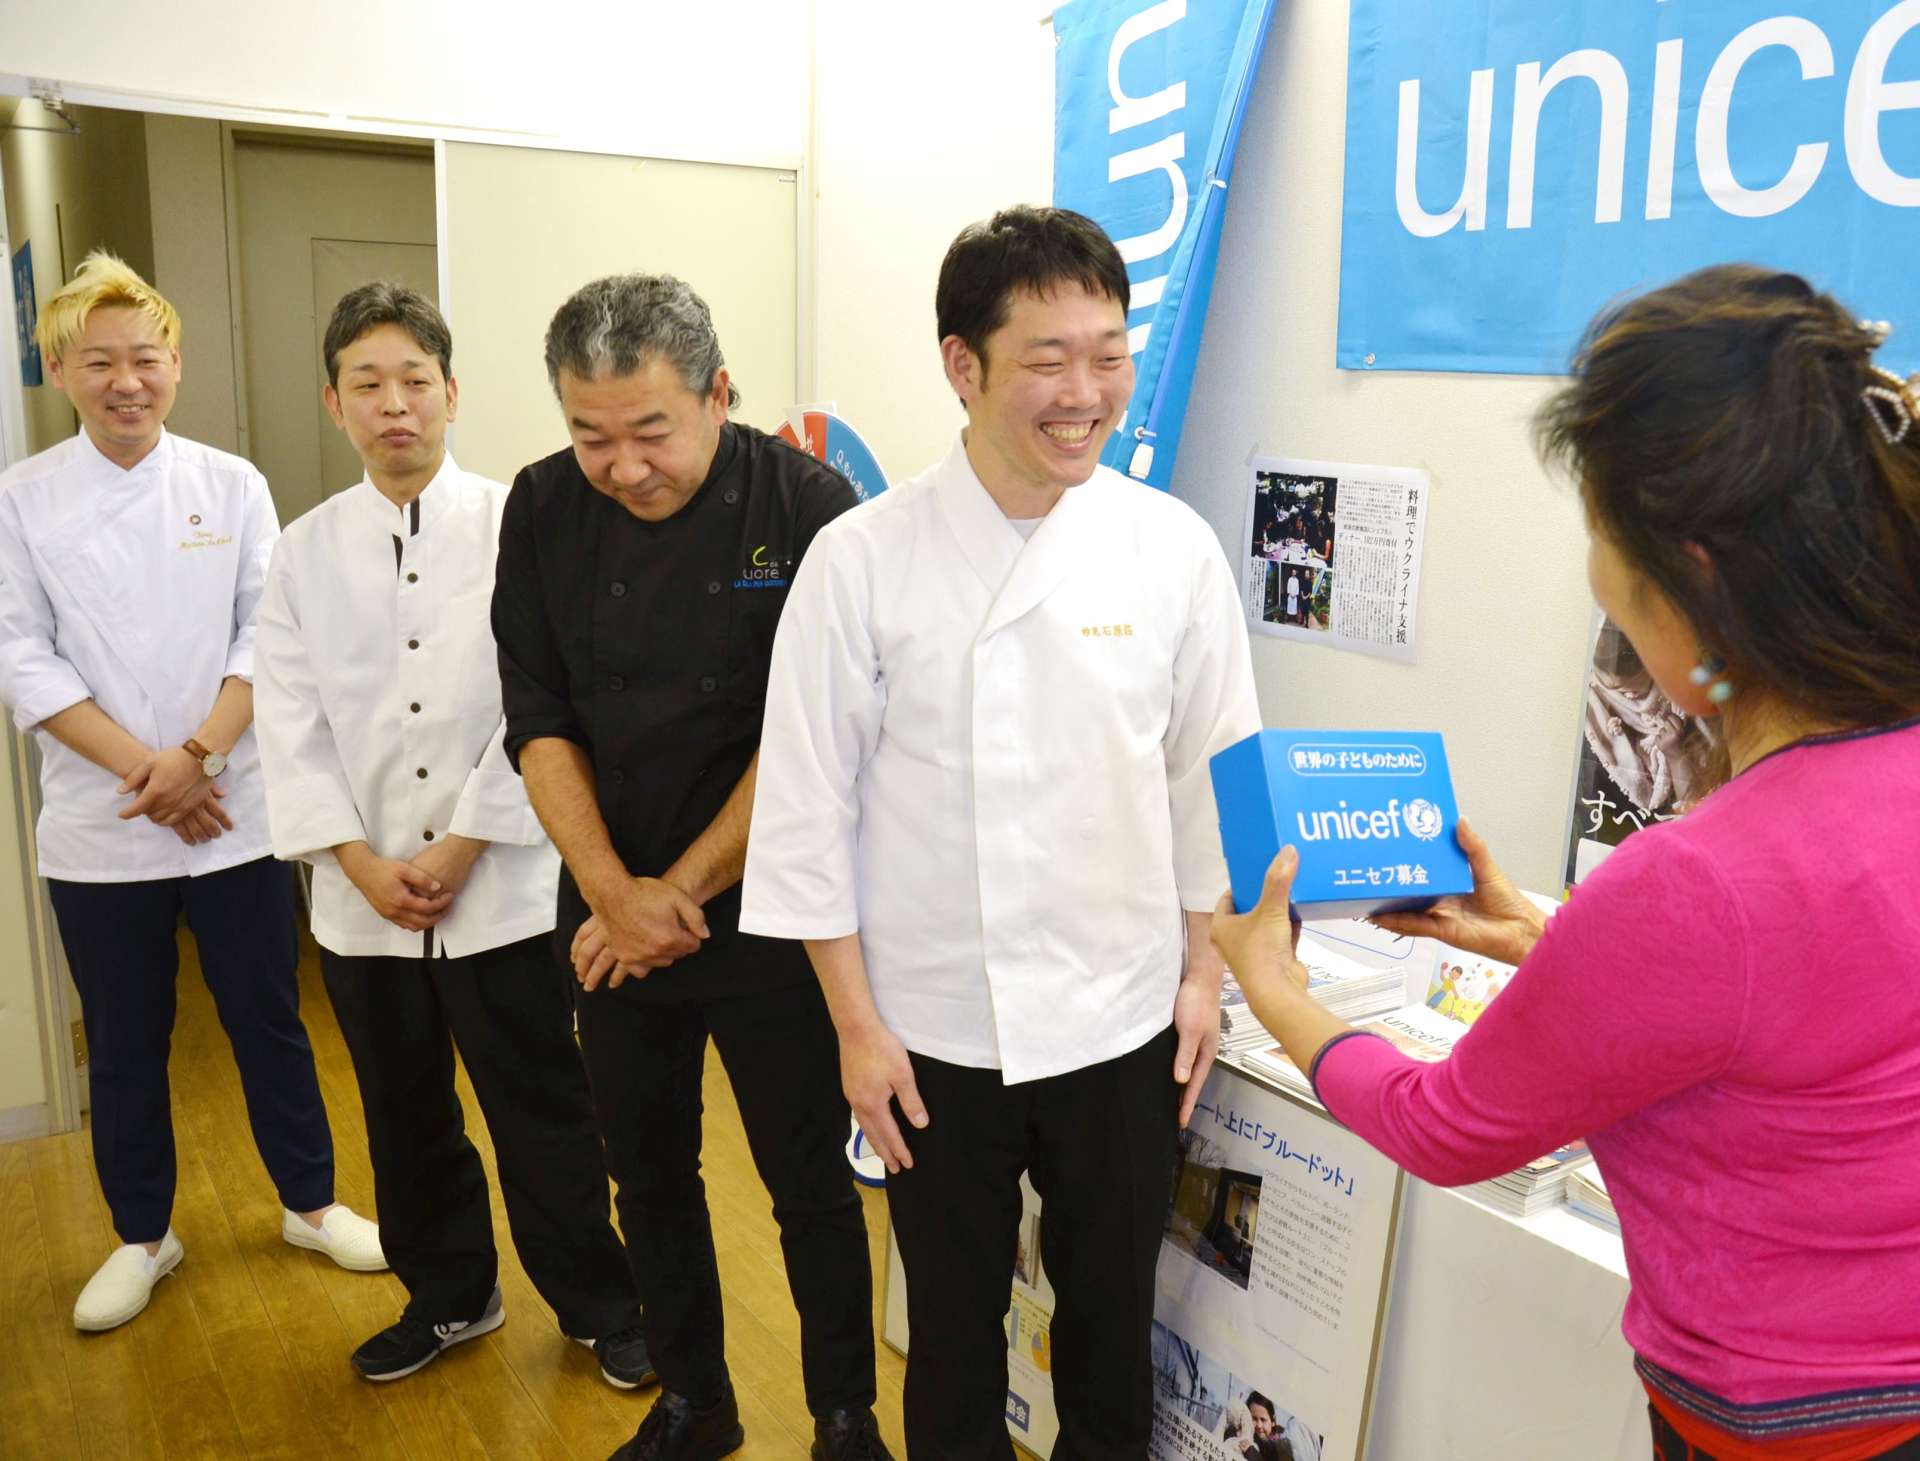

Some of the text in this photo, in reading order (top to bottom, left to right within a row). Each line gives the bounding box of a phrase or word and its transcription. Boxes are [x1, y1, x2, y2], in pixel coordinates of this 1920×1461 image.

[1396, 489, 1419, 645] 料理でウクライナ支援
[1293, 751, 1423, 770] 世界の子どものために
[1297, 799, 1401, 842] unicef
[1581, 790, 1685, 833] すべ
[1334, 864, 1429, 886] ユニセフ募金
[1194, 1103, 1354, 1196] ート上に「ブルードット」
